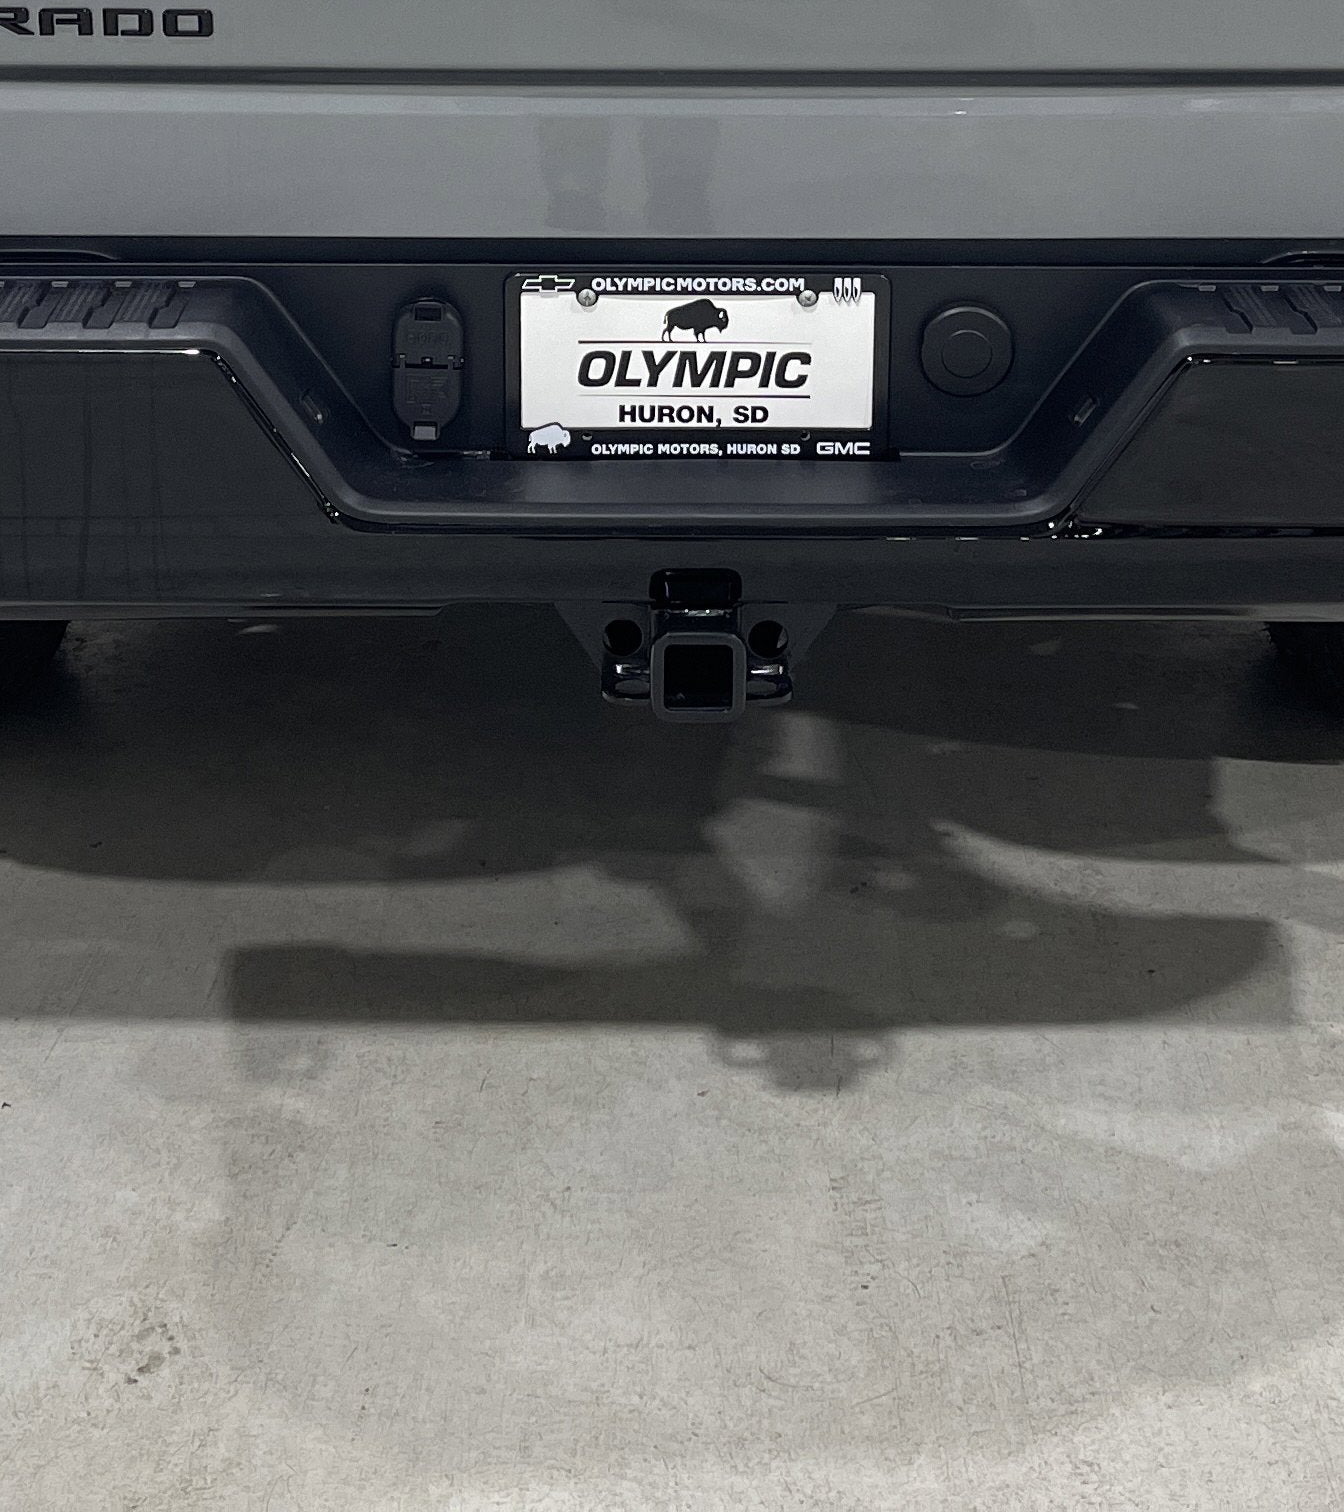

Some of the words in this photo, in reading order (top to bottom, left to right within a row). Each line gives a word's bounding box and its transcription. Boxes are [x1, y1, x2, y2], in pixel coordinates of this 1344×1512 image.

[591, 277, 805, 292] OLYMPICMOTORS.COM
[578, 350, 812, 389] OLYMPIC
[618, 404, 722, 427] HURON,
[732, 405, 769, 423] SD
[591, 443, 654, 455] OLYMPIC
[657, 443, 723, 456] MOTORS,
[726, 443, 777, 455] HURON
[780, 443, 801, 455] SD
[816, 441, 871, 455] GMC
